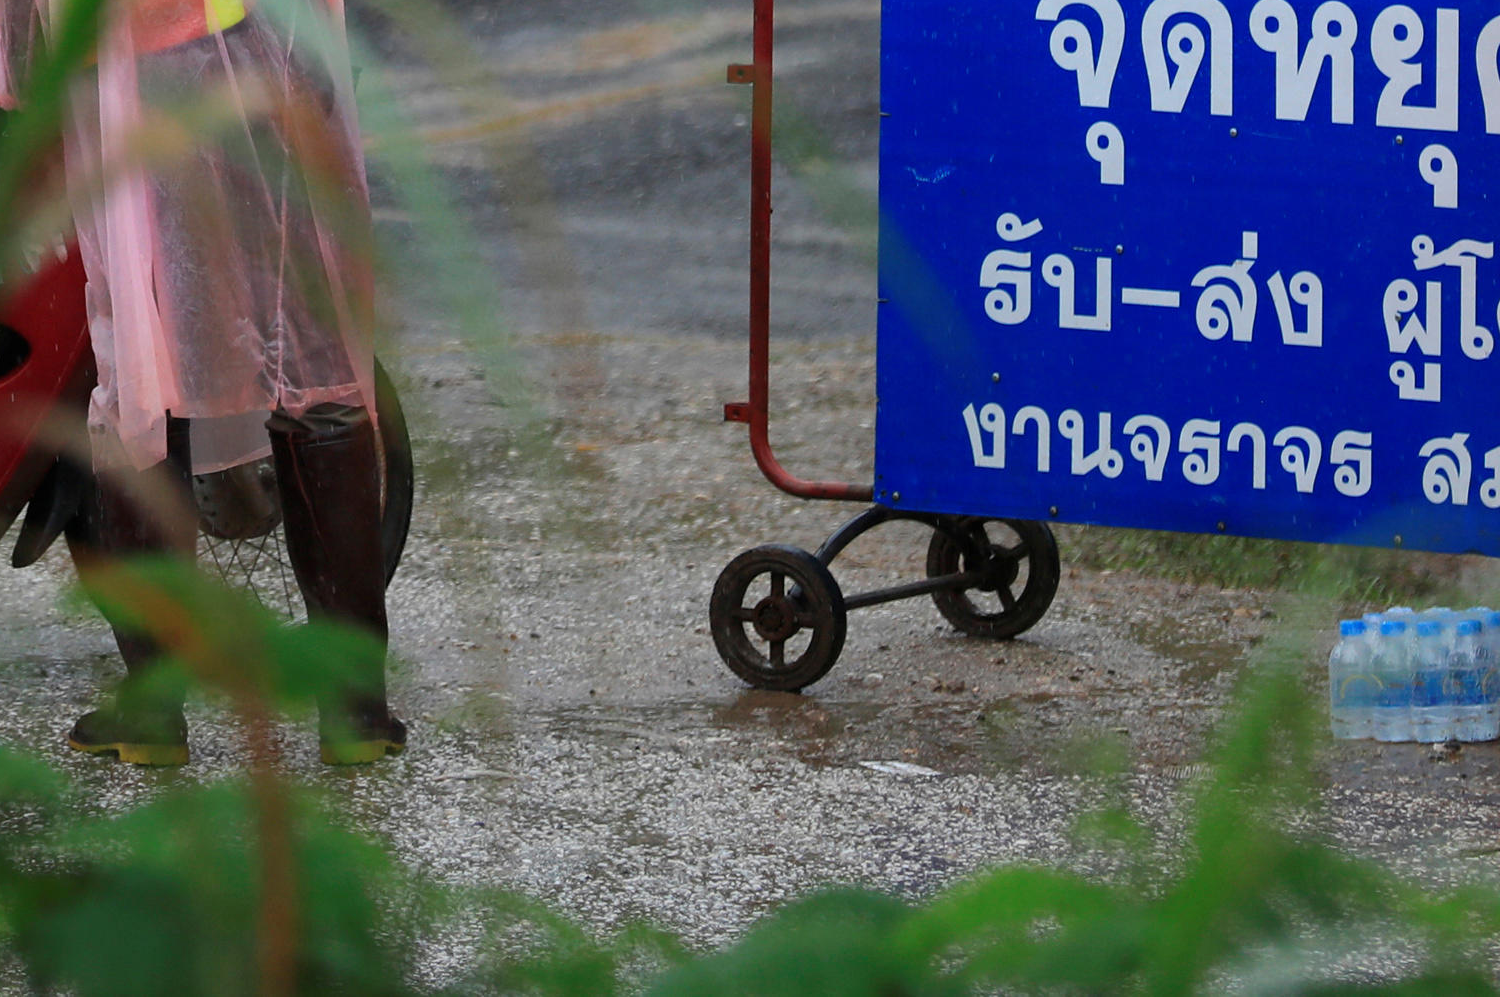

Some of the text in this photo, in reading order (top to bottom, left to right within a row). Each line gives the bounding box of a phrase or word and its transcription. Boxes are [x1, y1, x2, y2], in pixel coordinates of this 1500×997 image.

[1383, 235, 1500, 402] ผู้โ
[962, 403, 1373, 497] งานจราจร
